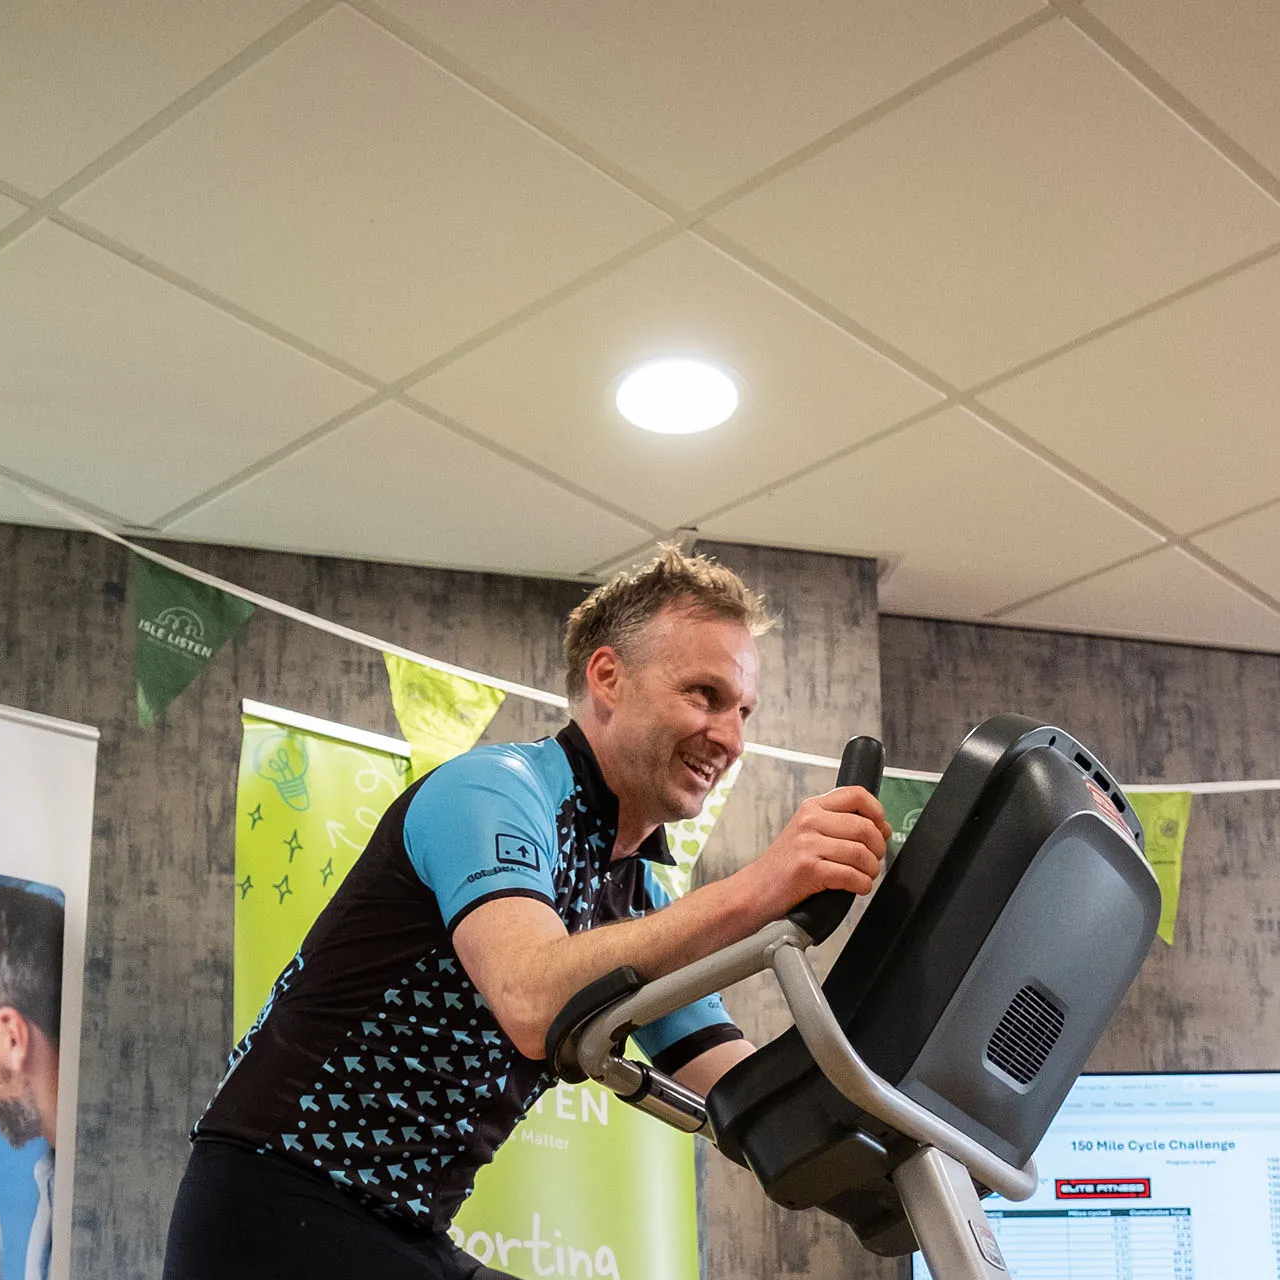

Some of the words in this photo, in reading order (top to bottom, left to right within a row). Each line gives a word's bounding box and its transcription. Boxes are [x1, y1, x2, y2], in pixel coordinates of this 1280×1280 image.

[138, 618, 166, 640] ISLE
[167, 633, 213, 658] LISTEN
[521, 1128, 569, 1150] Matter
[1071, 1140, 1093, 1151] 150
[1096, 1140, 1124, 1151] Mile
[1128, 1140, 1165, 1152] Cycle
[1169, 1139, 1236, 1152] Challenge
[1096, 1183, 1146, 1193] FITNESS
